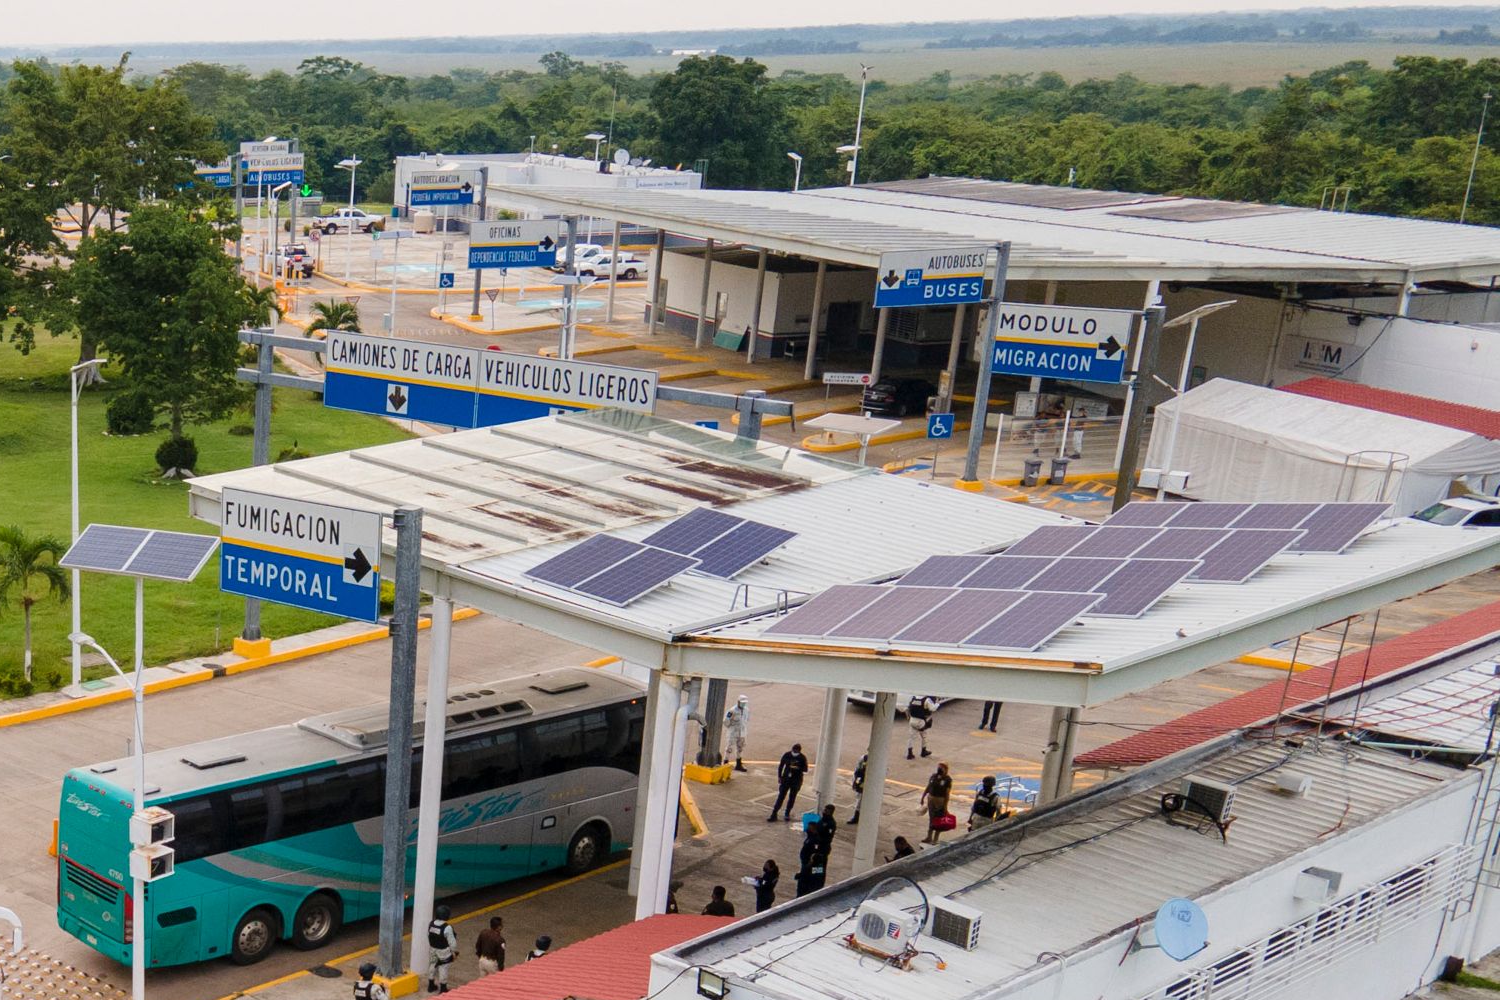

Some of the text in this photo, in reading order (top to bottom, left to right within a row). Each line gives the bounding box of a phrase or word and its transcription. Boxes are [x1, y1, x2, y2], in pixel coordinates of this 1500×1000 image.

[250, 172, 291, 182] AUOBUSES
[489, 226, 521, 239] OFICINAS
[470, 249, 537, 264] DEPENDENCIAS FEDERALES
[928, 253, 985, 270] AUTOBUSES
[923, 282, 980, 299] BUSES
[1000, 312, 1097, 335] MODULO
[331, 338, 472, 380] CAMIONES DE CARGA
[994, 347, 1092, 372] MIGRACION
[485, 359, 650, 405] VEHICULOS LIGEROS
[225, 501, 340, 546] FUMIGACION
[225, 555, 338, 602] TEMPORAL
